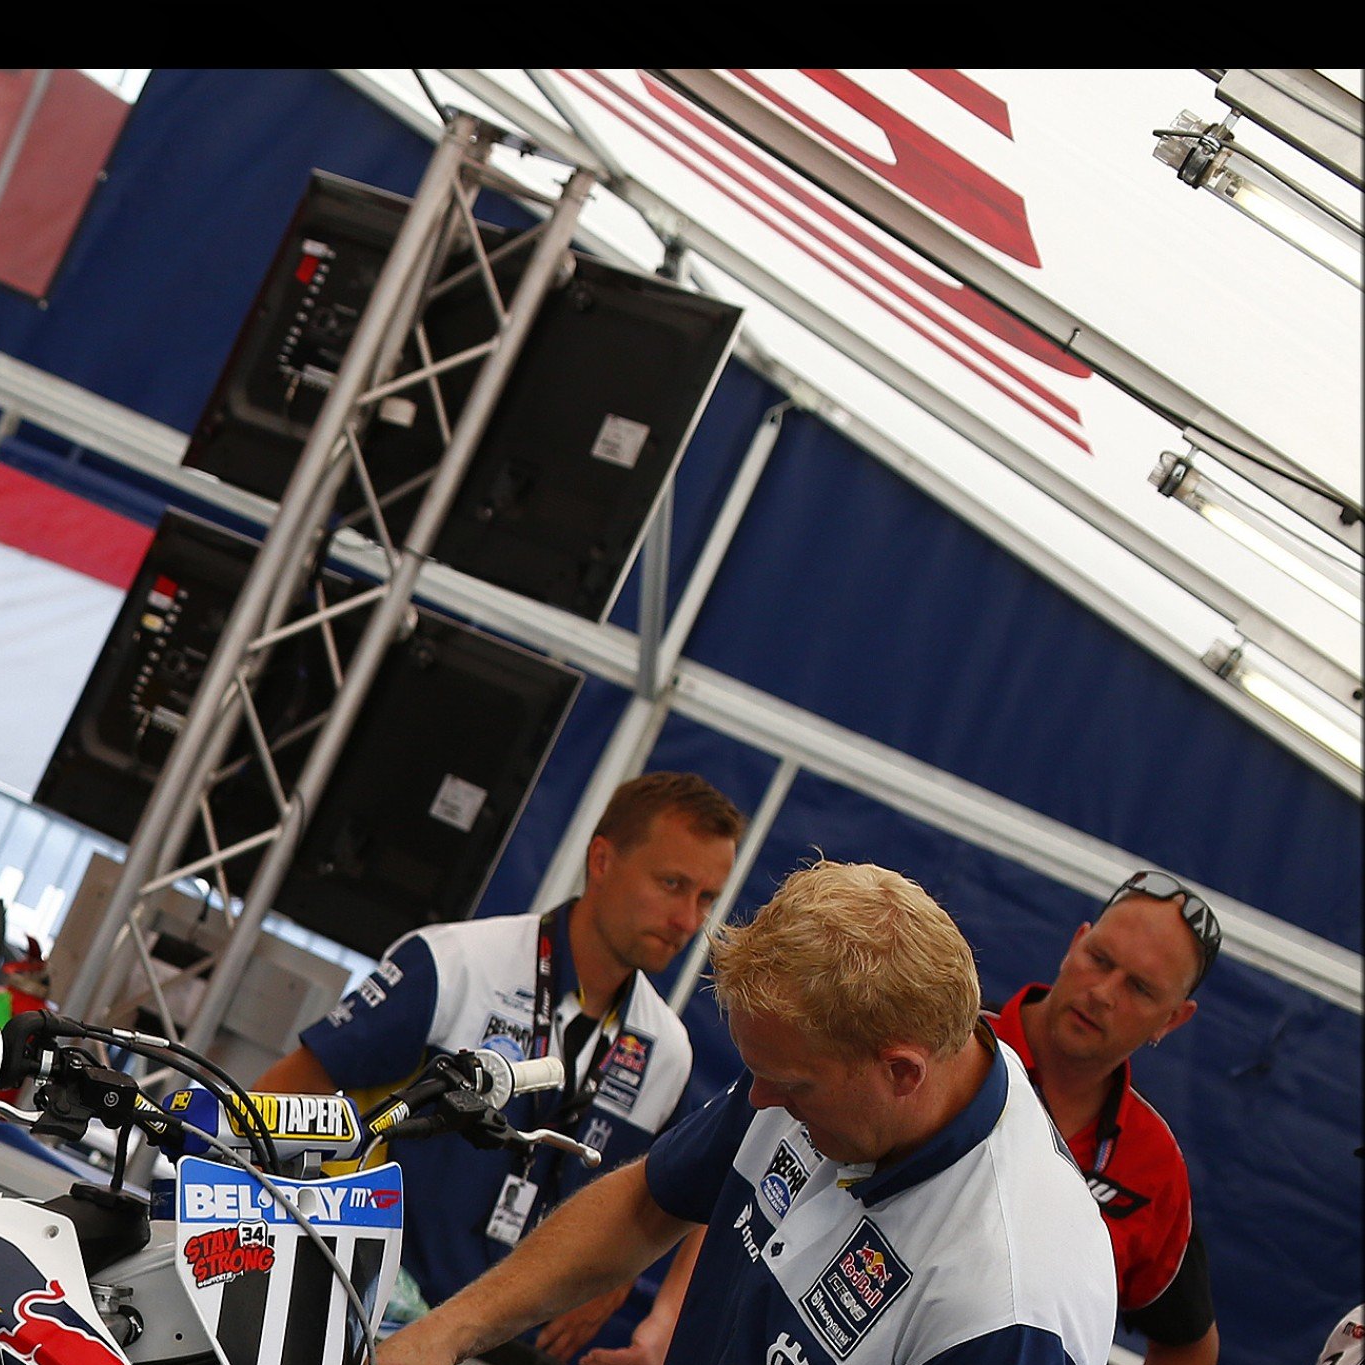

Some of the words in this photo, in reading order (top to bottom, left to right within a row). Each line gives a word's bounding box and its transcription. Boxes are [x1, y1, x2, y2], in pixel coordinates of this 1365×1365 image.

[184, 1227, 238, 1264] STAY
[241, 1226, 265, 1242] 34
[193, 1246, 276, 1282] STRONG
